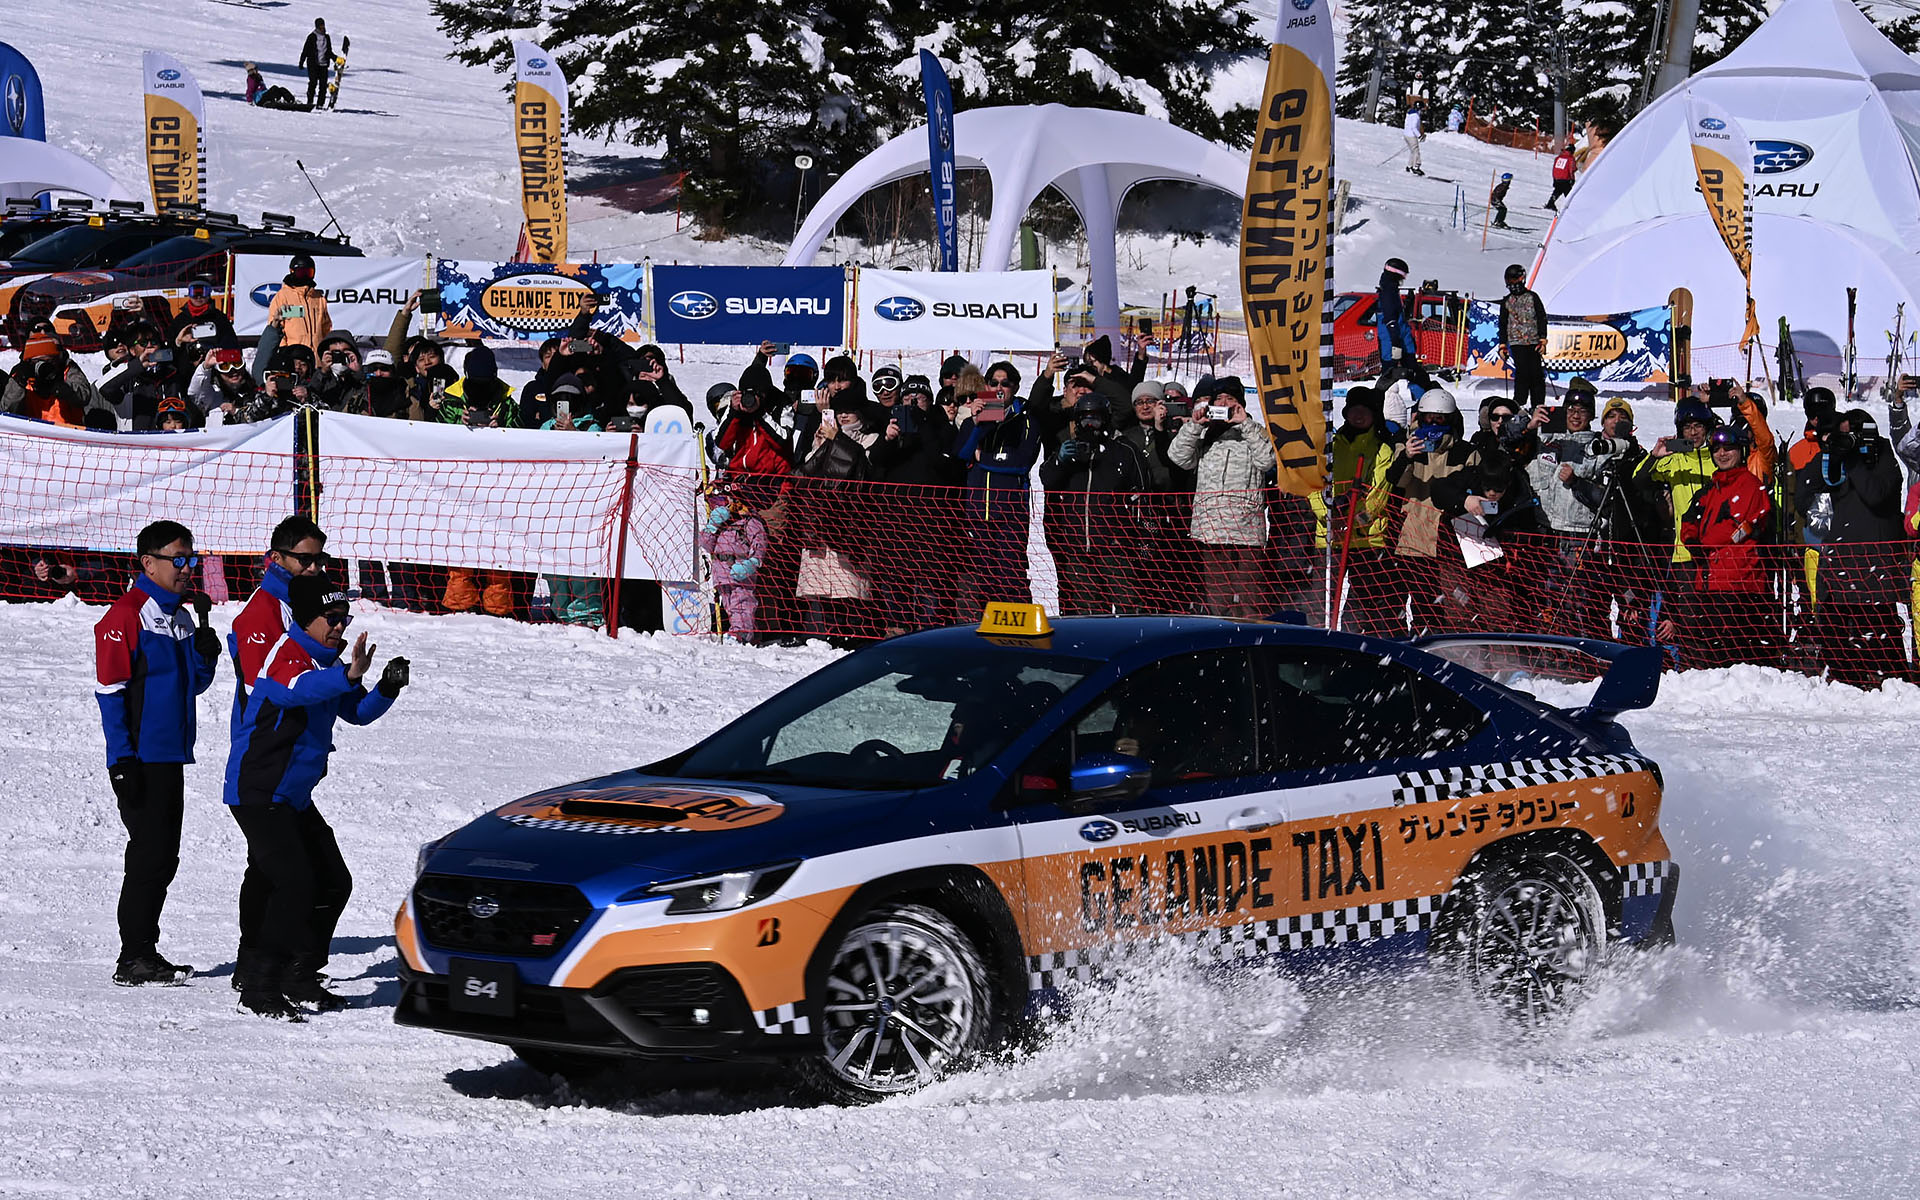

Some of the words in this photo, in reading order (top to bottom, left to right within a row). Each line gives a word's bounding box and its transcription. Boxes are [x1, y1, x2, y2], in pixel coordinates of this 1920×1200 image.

[317, 288, 409, 305] UBARU
[490, 289, 553, 309] GELANDE
[559, 291, 585, 310] TAX
[725, 297, 831, 315] SUBARU
[932, 302, 1039, 320] SUBARU
[1588, 334, 1617, 351] TAXI
[992, 609, 1027, 627] TAXI
[1122, 811, 1201, 834] SUBARU
[1080, 836, 1275, 933] GELANDE
[1292, 821, 1385, 901] TAXI
[463, 975, 499, 999] S4
